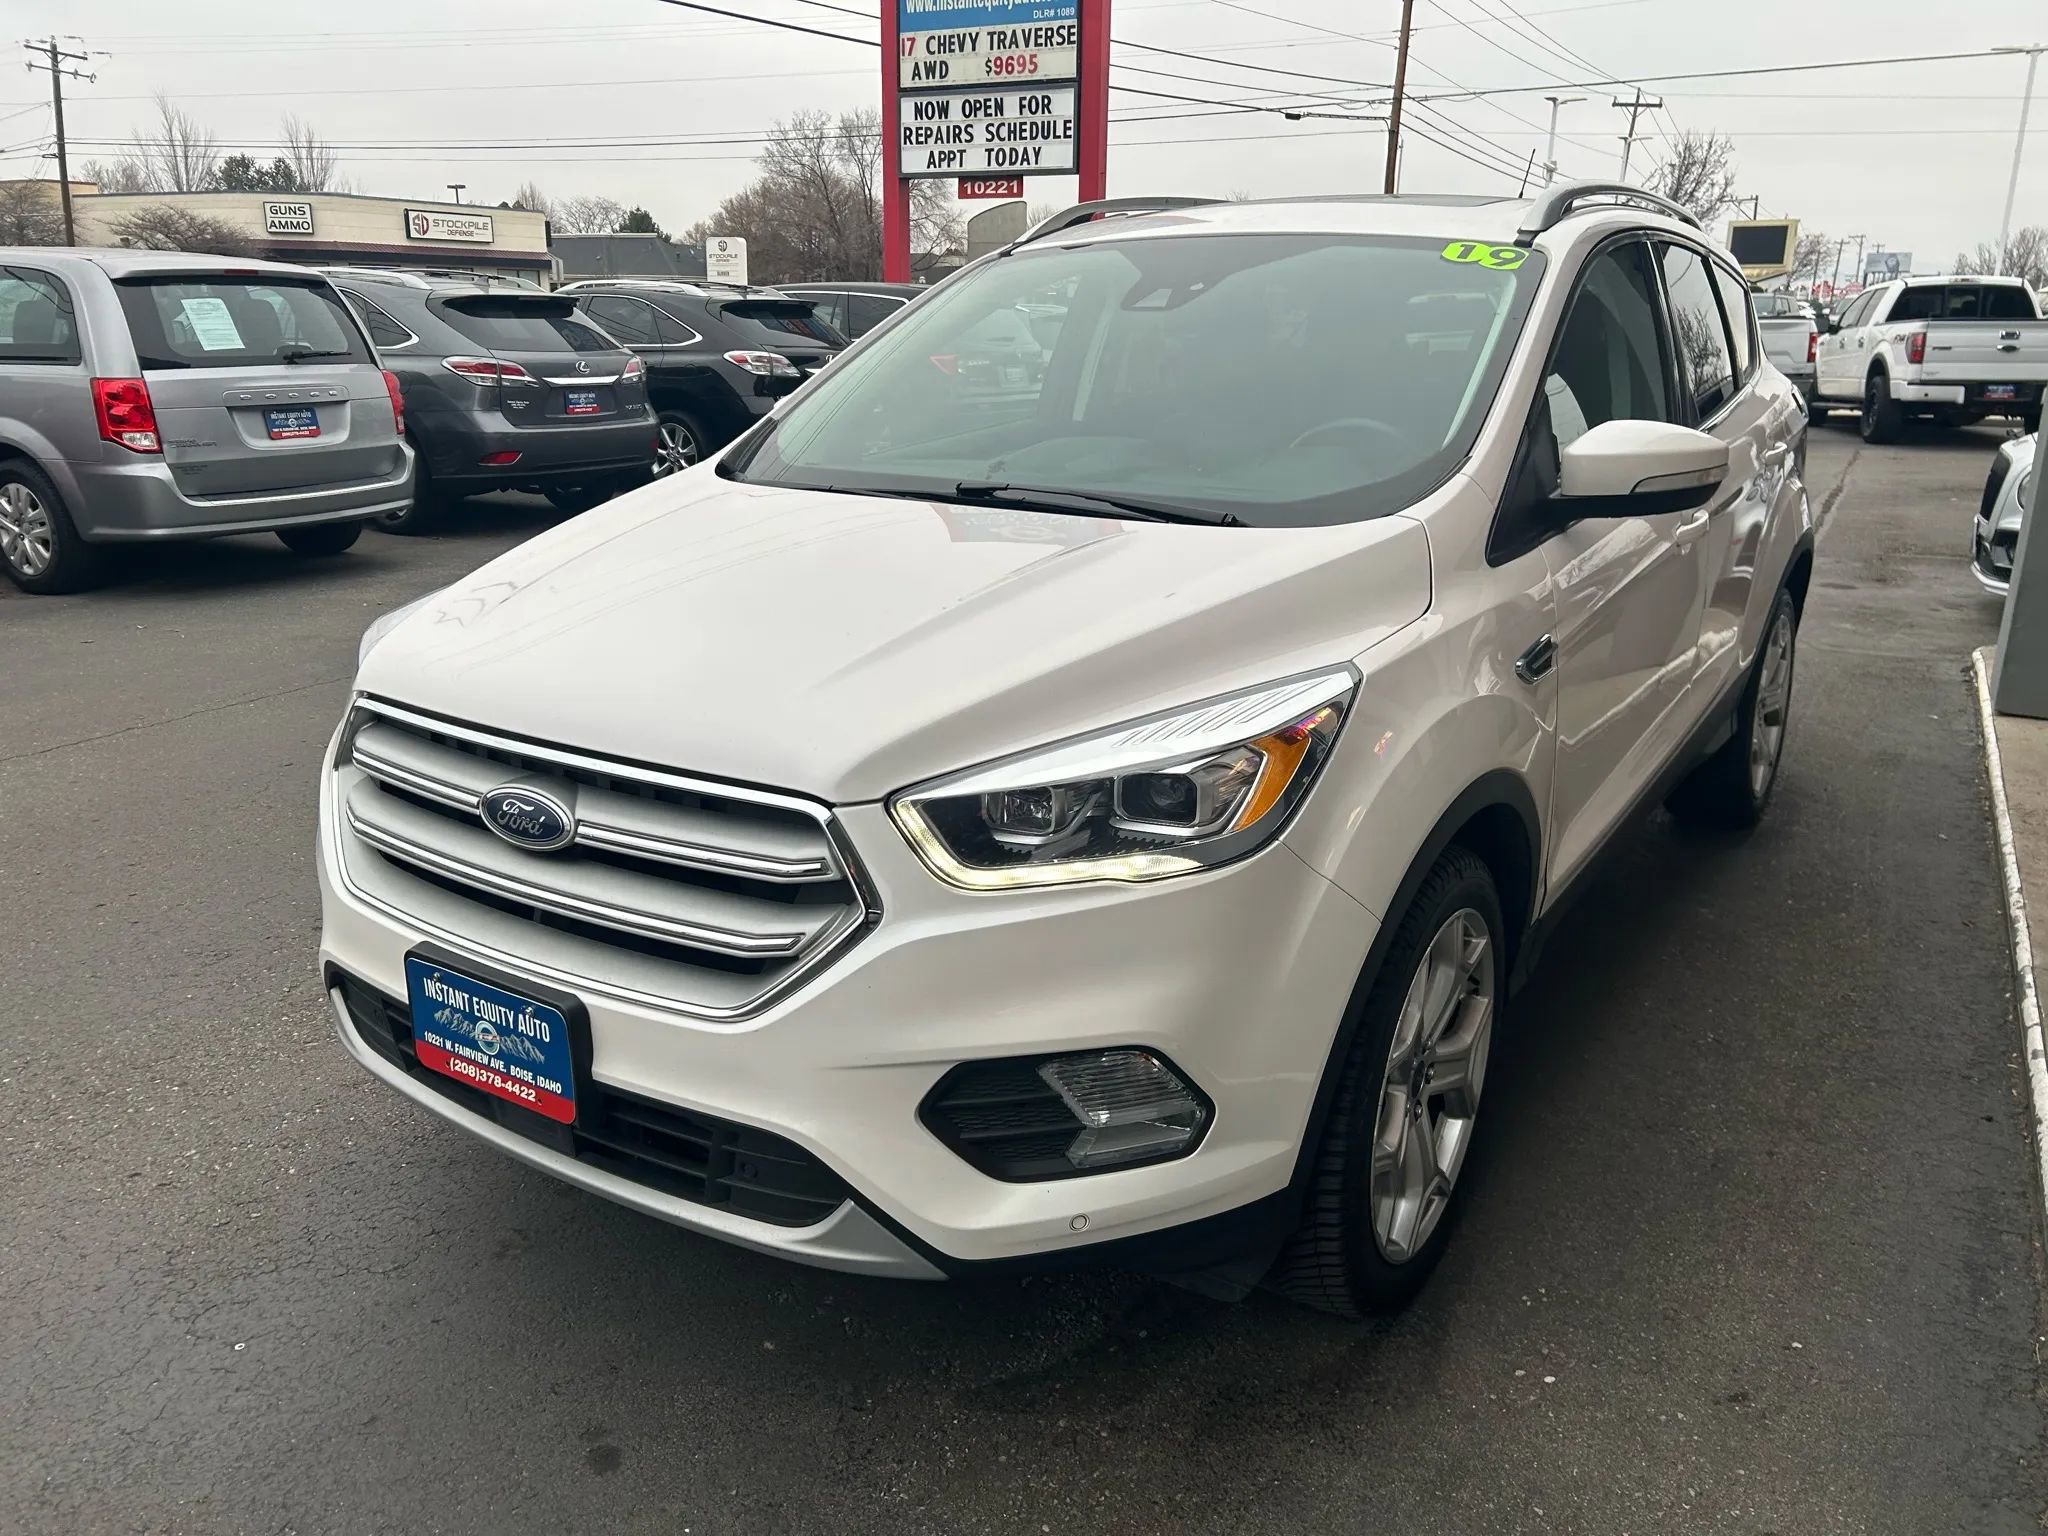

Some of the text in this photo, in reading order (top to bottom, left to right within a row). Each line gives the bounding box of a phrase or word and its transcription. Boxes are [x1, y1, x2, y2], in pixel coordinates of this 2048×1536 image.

[1033, 7, 1075, 19] DLR# 1089
[901, 25, 1077, 56] 17 CHEVY TRAVERSE
[911, 54, 1039, 81] AWD $9695
[914, 95, 1052, 121] NOW OPEN FOR
[903, 120, 1073, 145] REPAIRS SCHEDULE
[926, 147, 1042, 169] APPT TODAY
[963, 181, 1019, 195] 10221
[269, 205, 306, 216] GUNS
[268, 220, 311, 231] AMMO
[432, 218, 489, 231] STOCKPILE
[447, 229, 475, 237] DEFENSE
[1456, 243, 1526, 267] 19
[497, 799, 546, 835] Ford
[423, 977, 551, 1043] INSTANT EQUITY AUTO
[424, 1031, 562, 1095] 10221 W. FAIRVIEW AVE. BOISE, IDAHO
[449, 1057, 537, 1103] (208)378-4422
